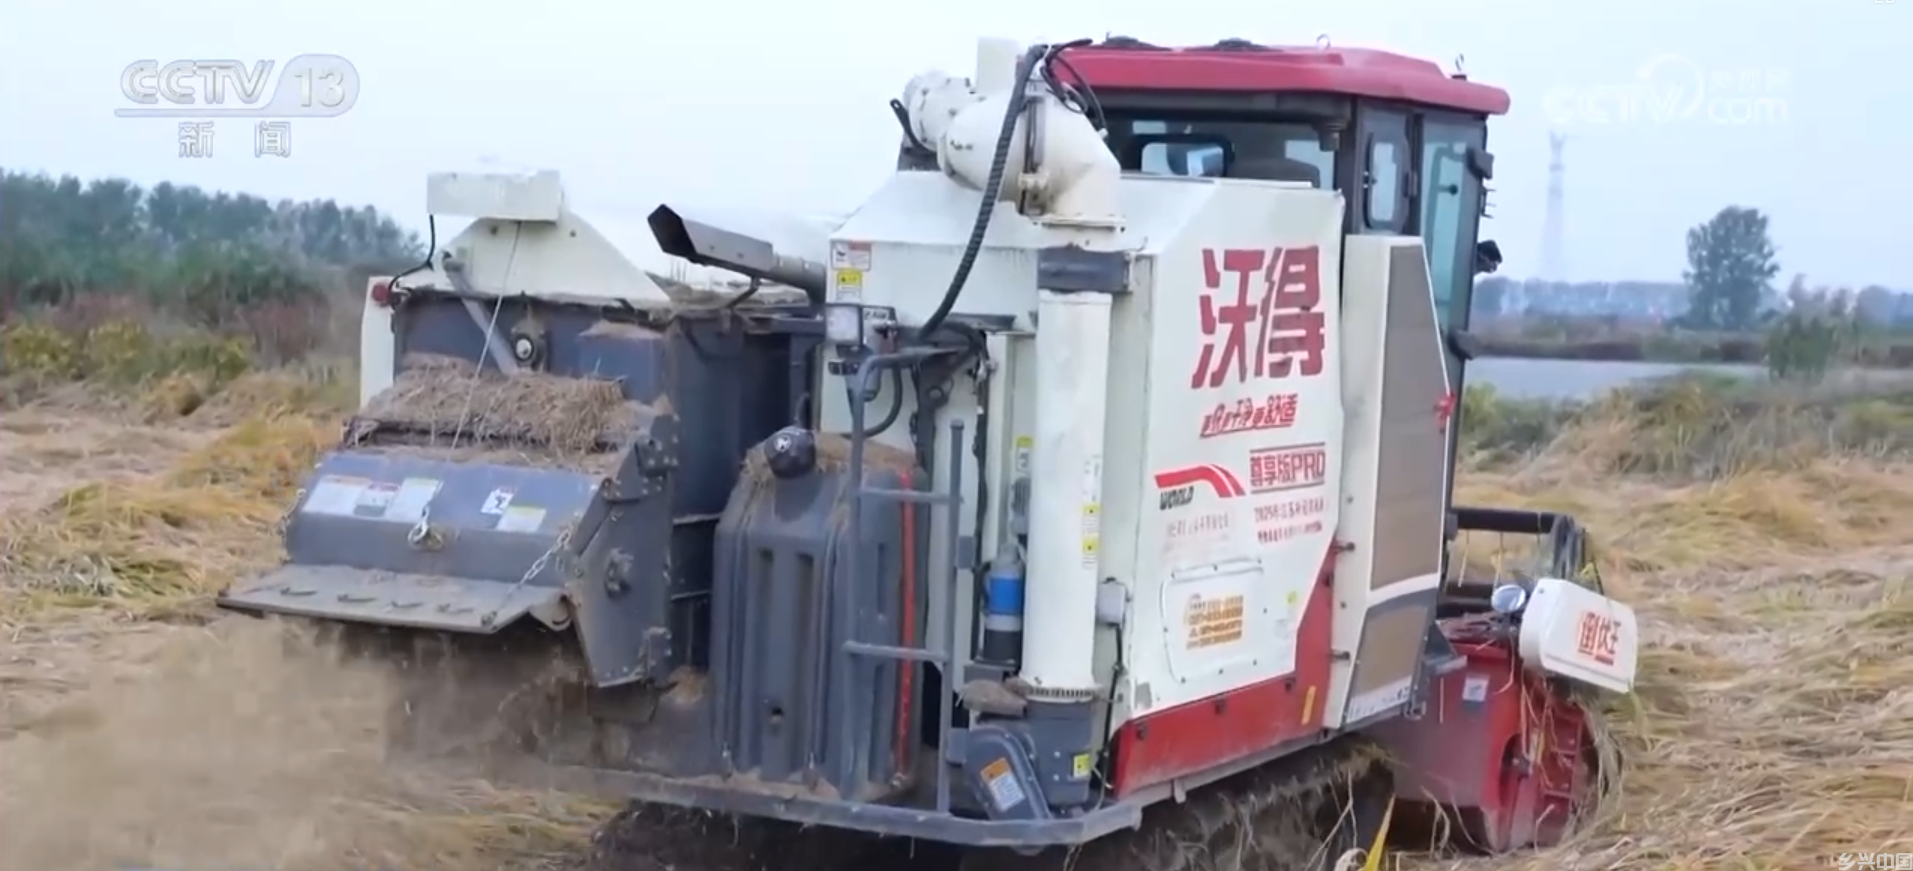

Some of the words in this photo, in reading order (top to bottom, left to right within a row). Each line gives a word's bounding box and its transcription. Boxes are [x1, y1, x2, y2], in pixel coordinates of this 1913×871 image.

[1191, 245, 1325, 388] 沃得
[1250, 451, 1325, 487] 尊享版PRO
[1159, 485, 1195, 511] WORLD
